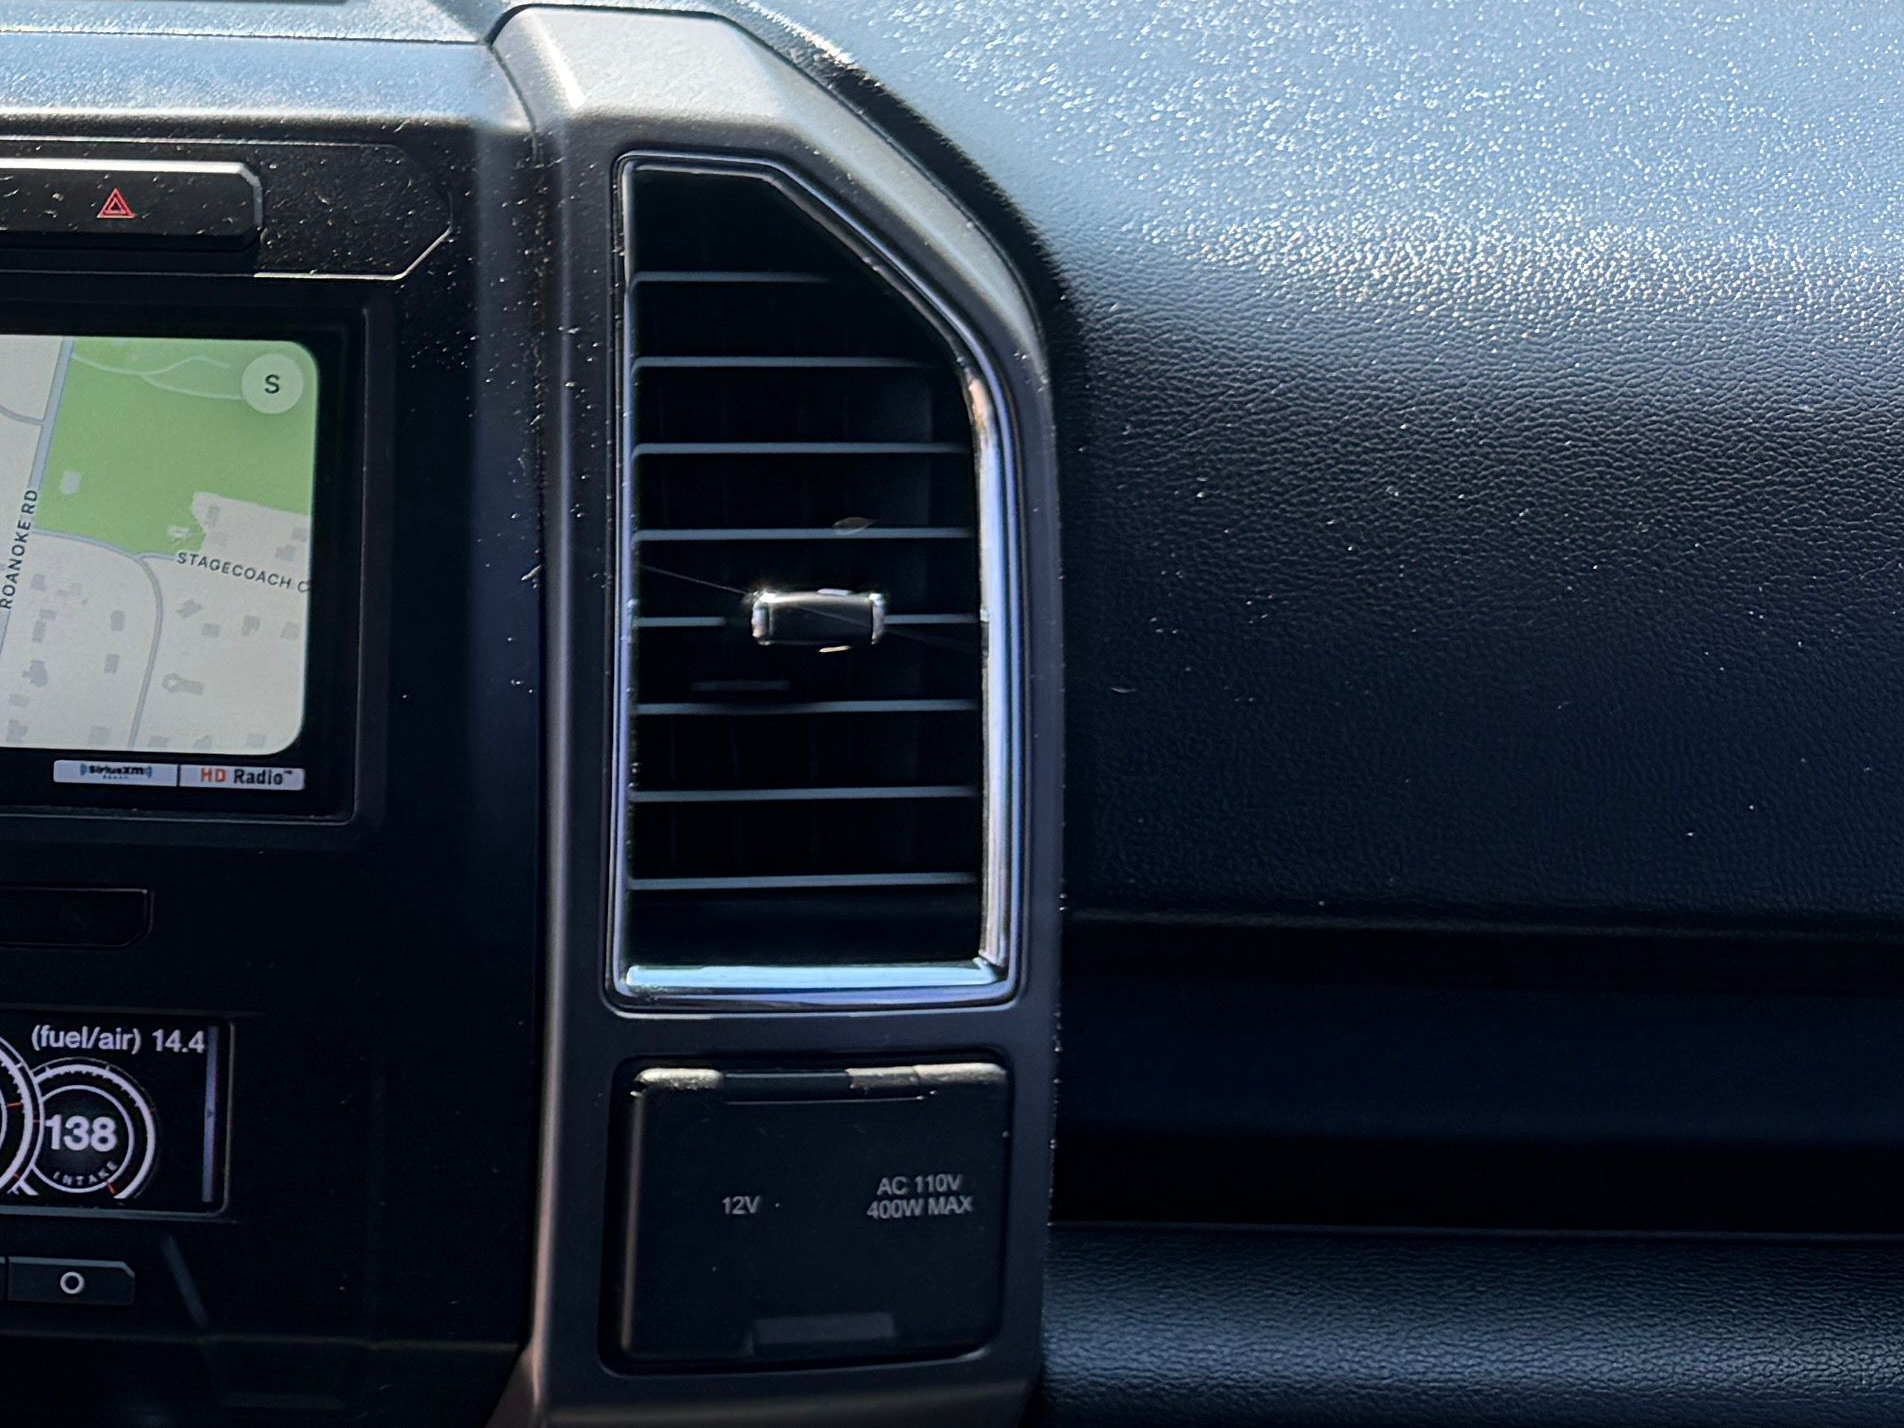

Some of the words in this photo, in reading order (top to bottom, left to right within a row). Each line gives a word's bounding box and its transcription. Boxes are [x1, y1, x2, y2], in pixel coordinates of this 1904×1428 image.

[263, 373, 281, 395] S
[0, 518, 32, 611] ROANOKE
[21, 489, 39, 515] RD
[177, 550, 292, 590] STAGECOACH
[200, 767, 227, 783] HD
[31, 1024, 142, 1055] (fuel/air)
[151, 1029, 206, 1053] 14.4
[45, 1114, 118, 1153] 138
[53, 1160, 118, 1186] INTAKE
[876, 1176, 908, 1196] AC
[914, 1174, 963, 1193] 110V
[721, 1195, 761, 1215] 12V
[867, 1197, 923, 1220] 400W
[928, 1195, 974, 1217] MAX
